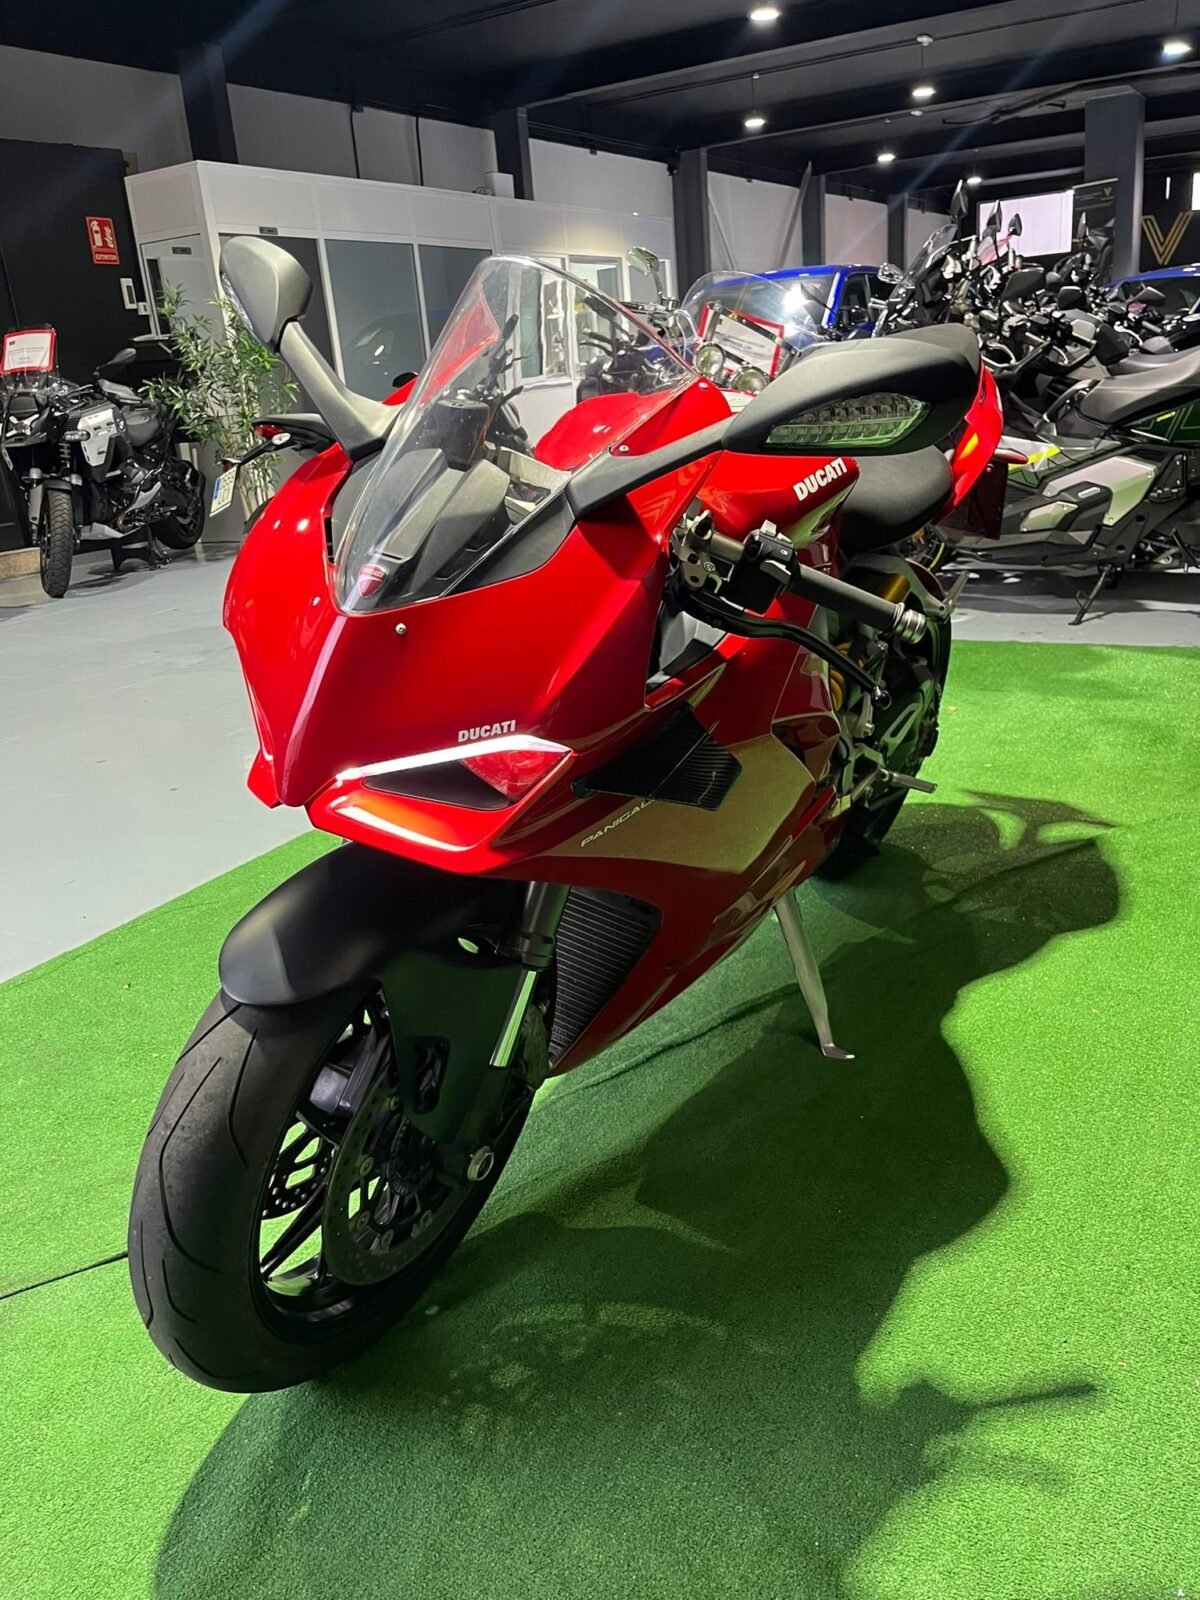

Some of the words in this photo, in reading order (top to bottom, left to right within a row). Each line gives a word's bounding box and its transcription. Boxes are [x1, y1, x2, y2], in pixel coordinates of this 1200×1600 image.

[792, 457, 848, 501] DUCATI
[458, 719, 516, 743] DUCATI
[581, 799, 654, 847] PANIGAL
